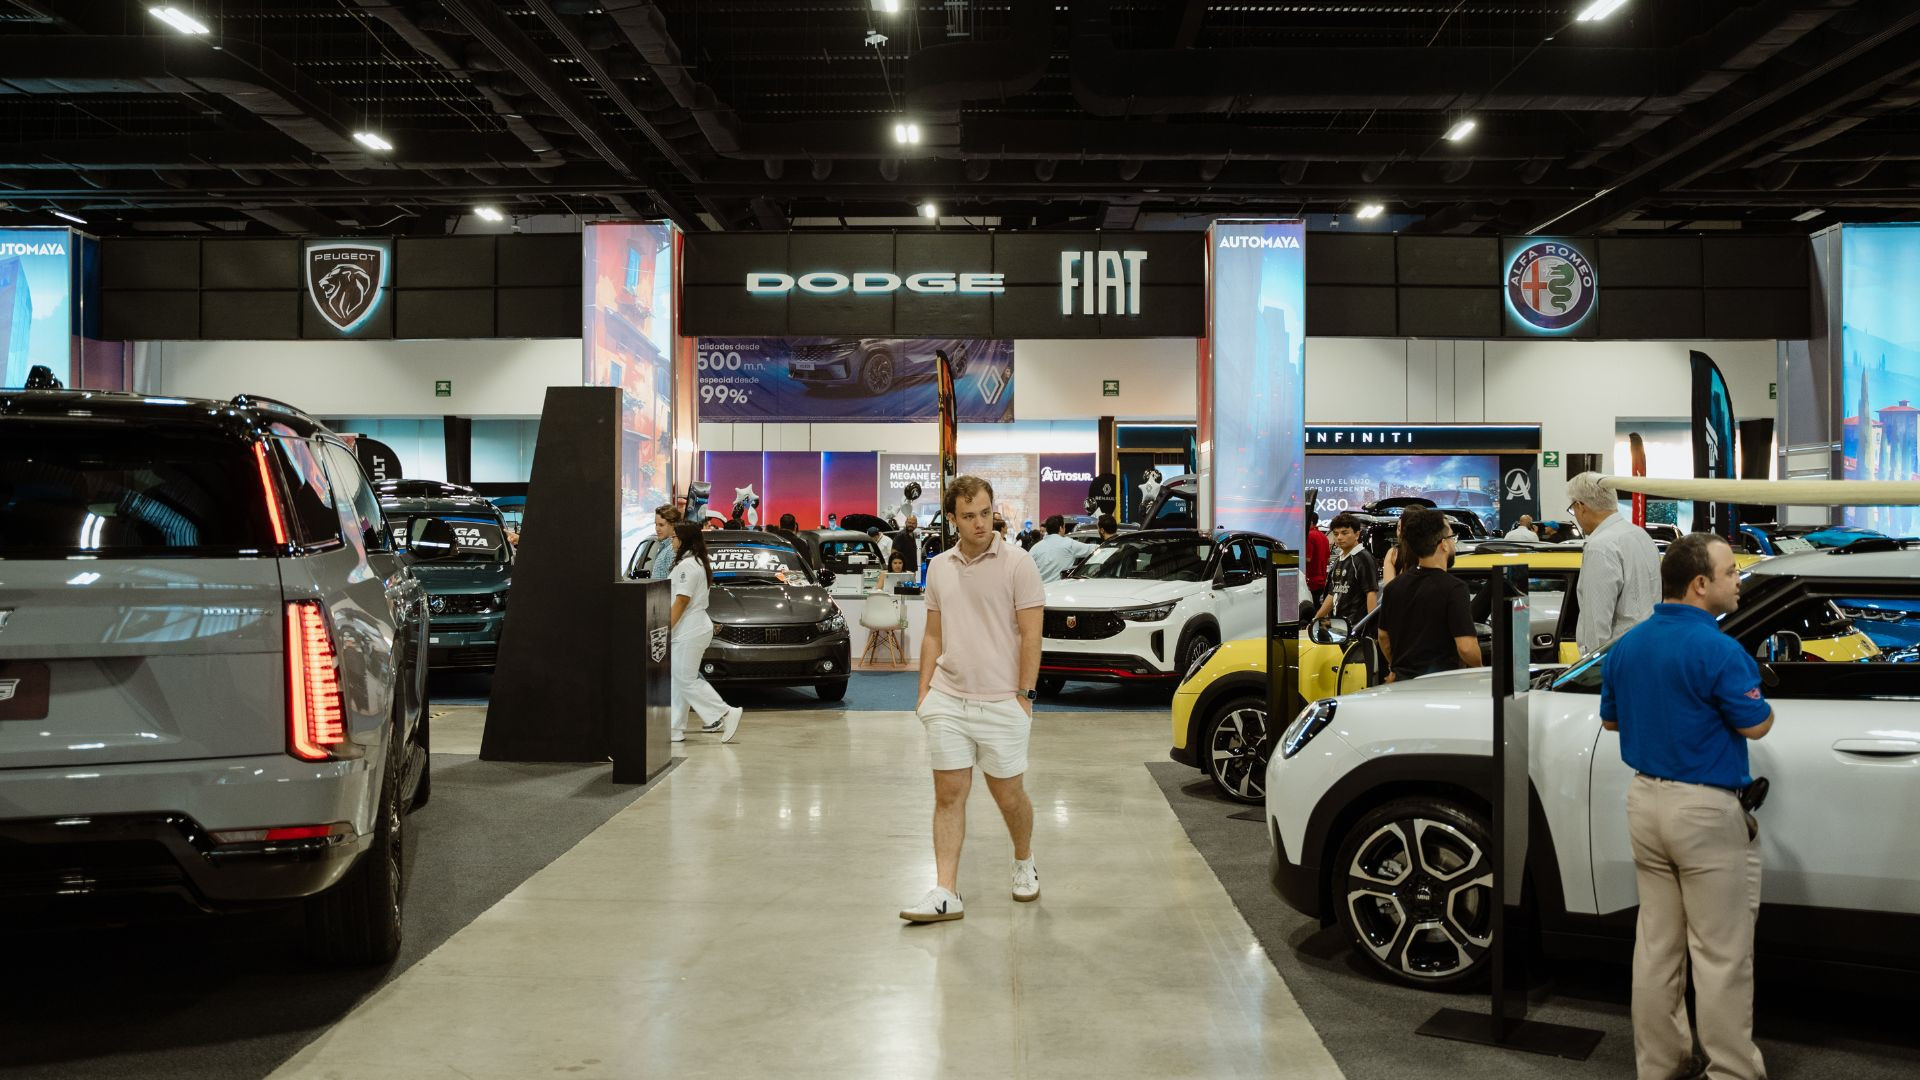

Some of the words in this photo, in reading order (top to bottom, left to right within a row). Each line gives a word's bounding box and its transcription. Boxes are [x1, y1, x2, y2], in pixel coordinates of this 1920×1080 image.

[1218, 235, 1301, 249] AUTOMAYA
[314, 253, 376, 262] PEUGEOT
[1510, 250, 1539, 286] ALFA
[1545, 245, 1593, 288] ROMEO
[746, 272, 1005, 293] DODGE
[1061, 250, 1148, 315] FIAT
[697, 343, 734, 351] alidades
[734, 343, 760, 351] desde
[697, 351, 742, 371] 500
[699, 376, 734, 385] especial
[734, 376, 760, 384] desde
[1305, 432, 1412, 443] INFINITI
[889, 463, 932, 472] RENAULT
[889, 472, 929, 481] MEGANE
